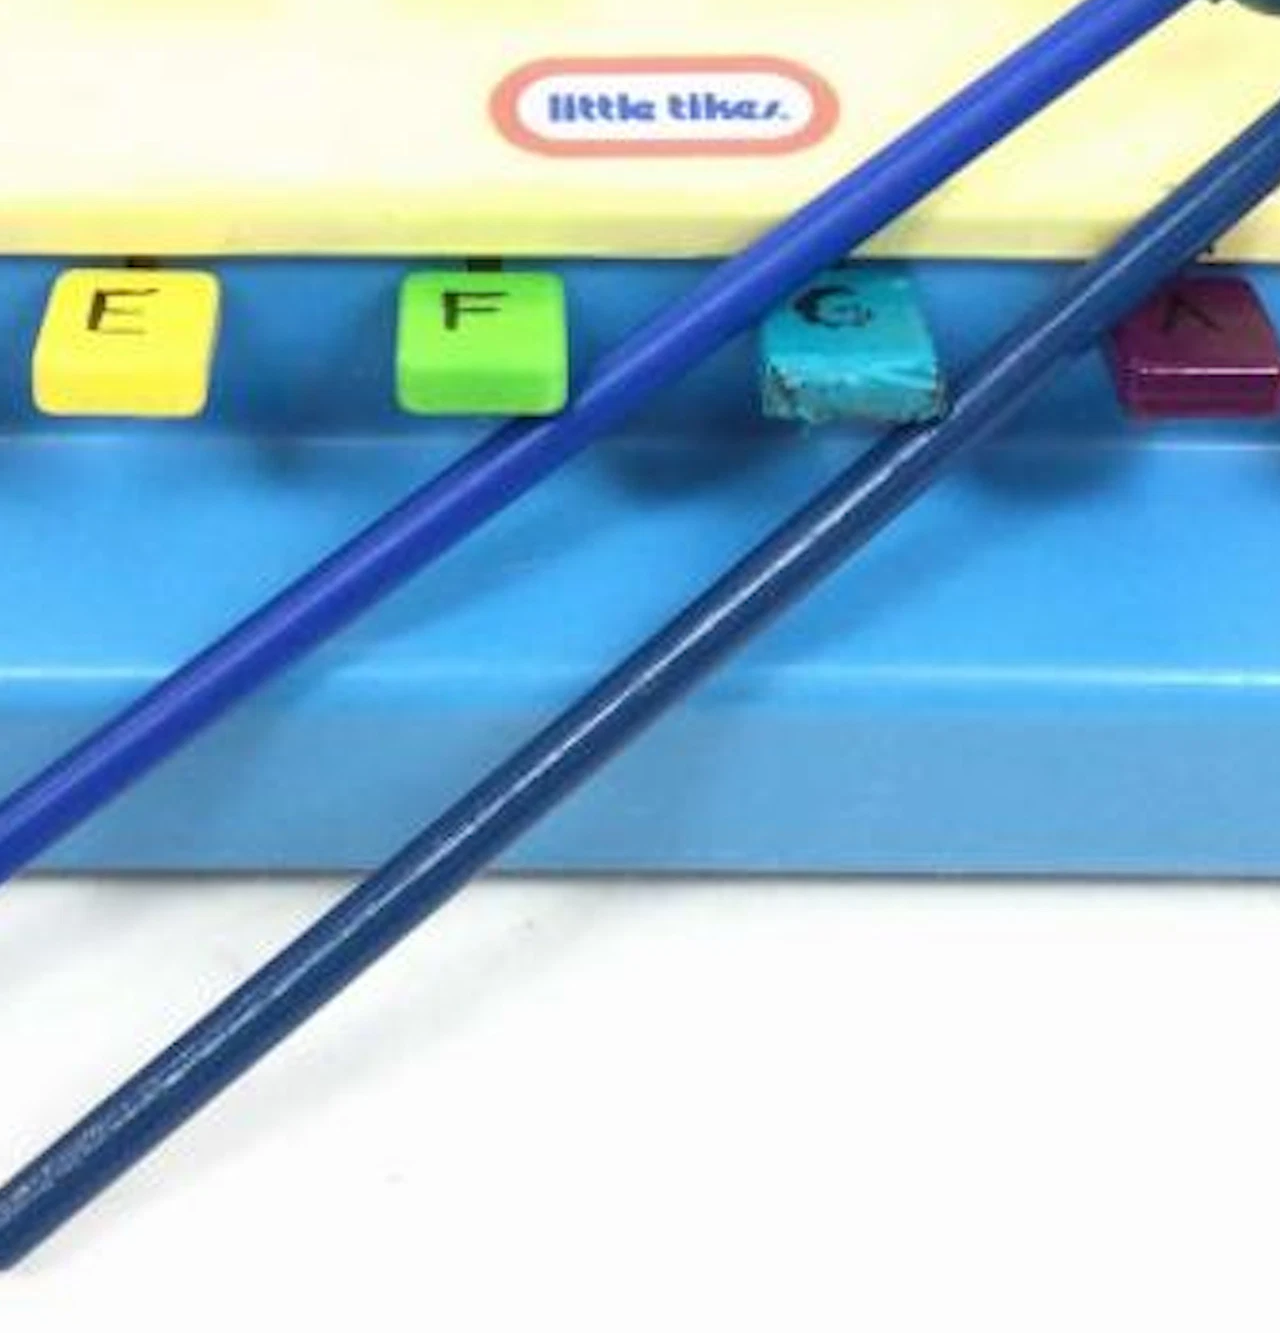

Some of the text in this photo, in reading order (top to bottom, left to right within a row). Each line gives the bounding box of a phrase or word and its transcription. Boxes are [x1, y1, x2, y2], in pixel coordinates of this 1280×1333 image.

[547, 92, 656, 123] little
[86, 287, 161, 333] E
[441, 291, 510, 331] F
